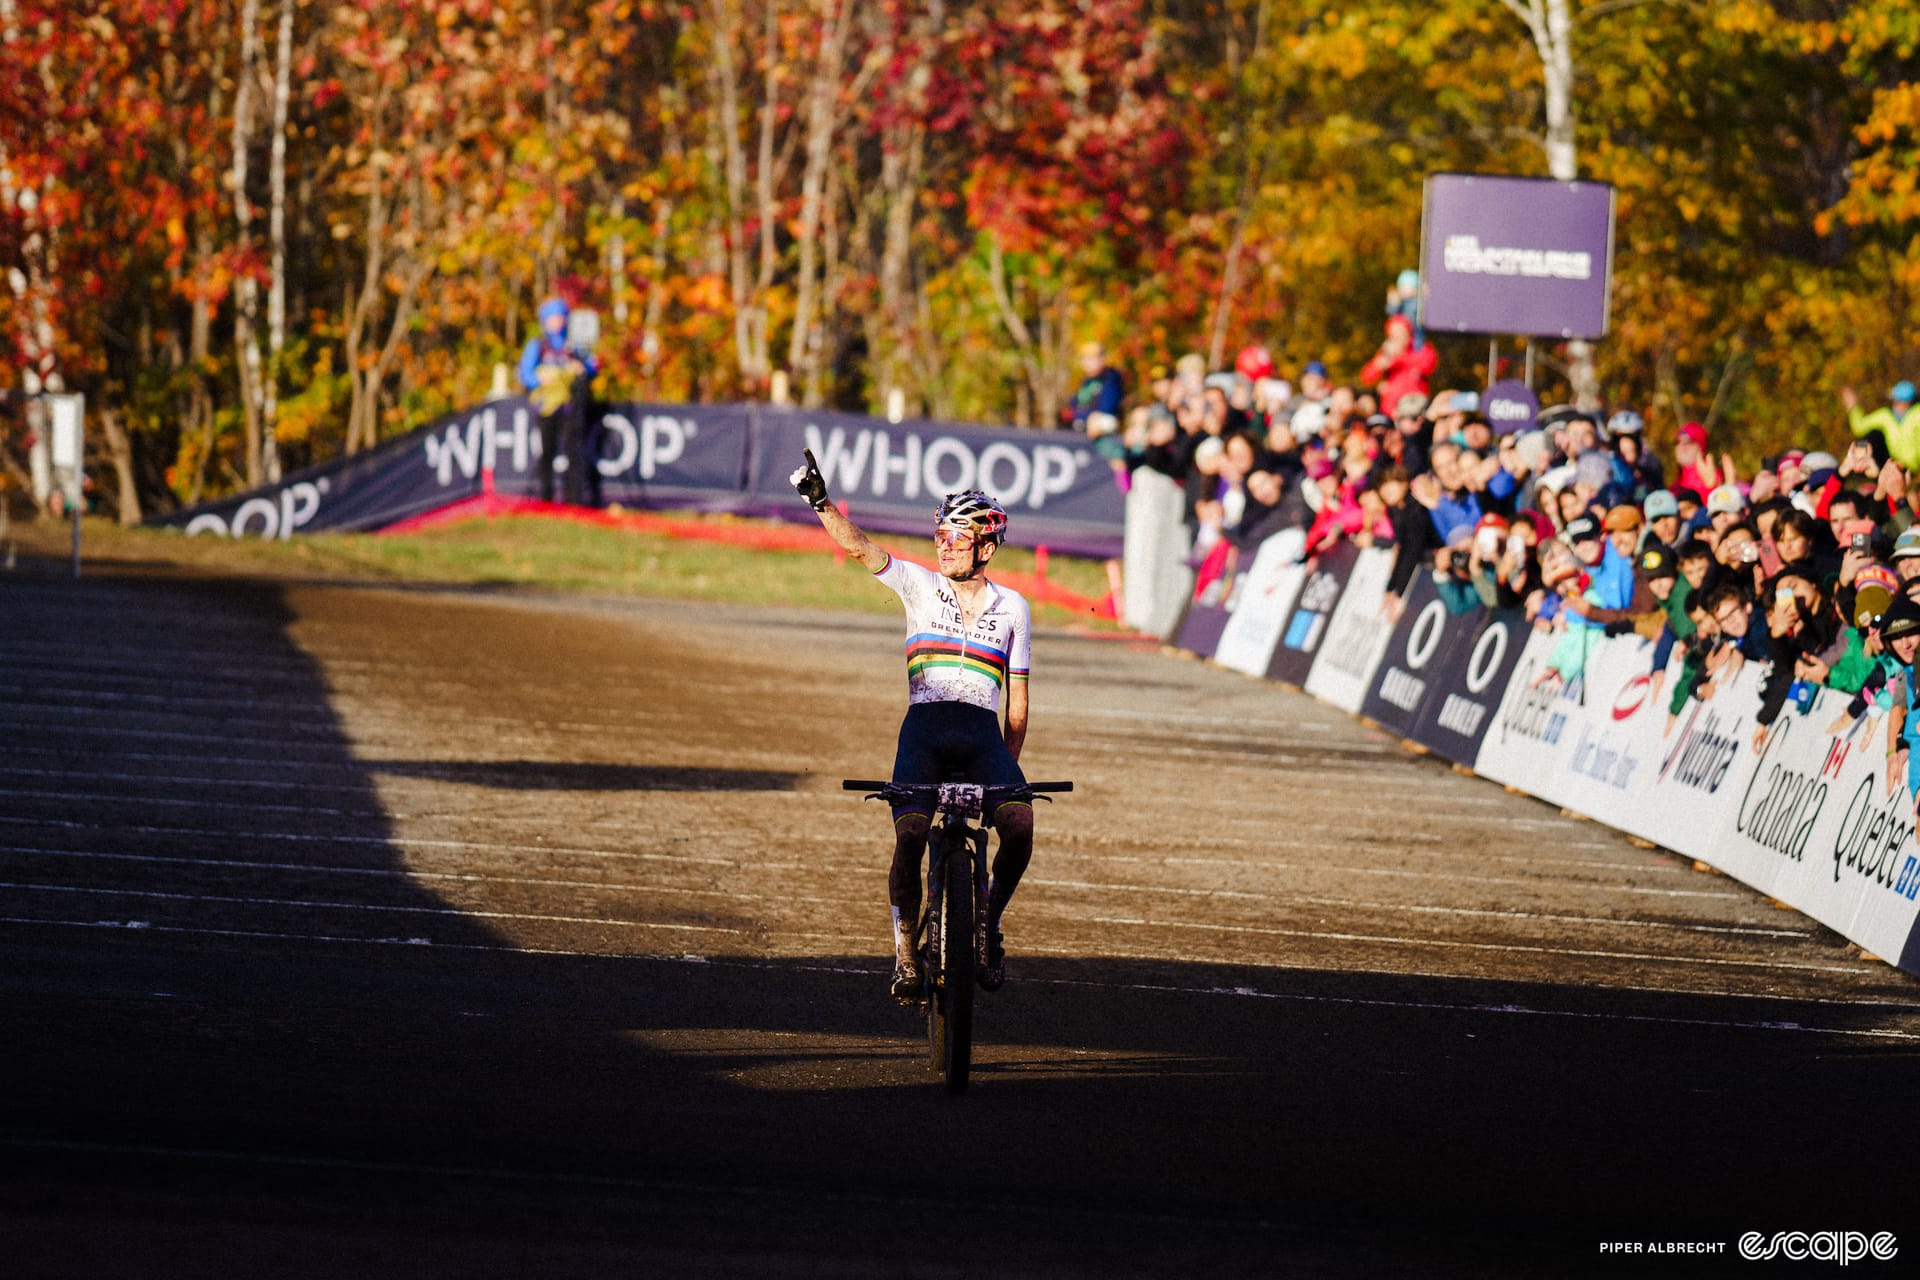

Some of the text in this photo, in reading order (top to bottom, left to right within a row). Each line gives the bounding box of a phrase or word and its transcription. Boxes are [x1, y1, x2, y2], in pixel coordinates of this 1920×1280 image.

[425, 408, 686, 486] WHOP
[804, 424, 1077, 509] WHOOP
[1737, 715, 1837, 863] Canada
[1834, 771, 1916, 890] Québec
